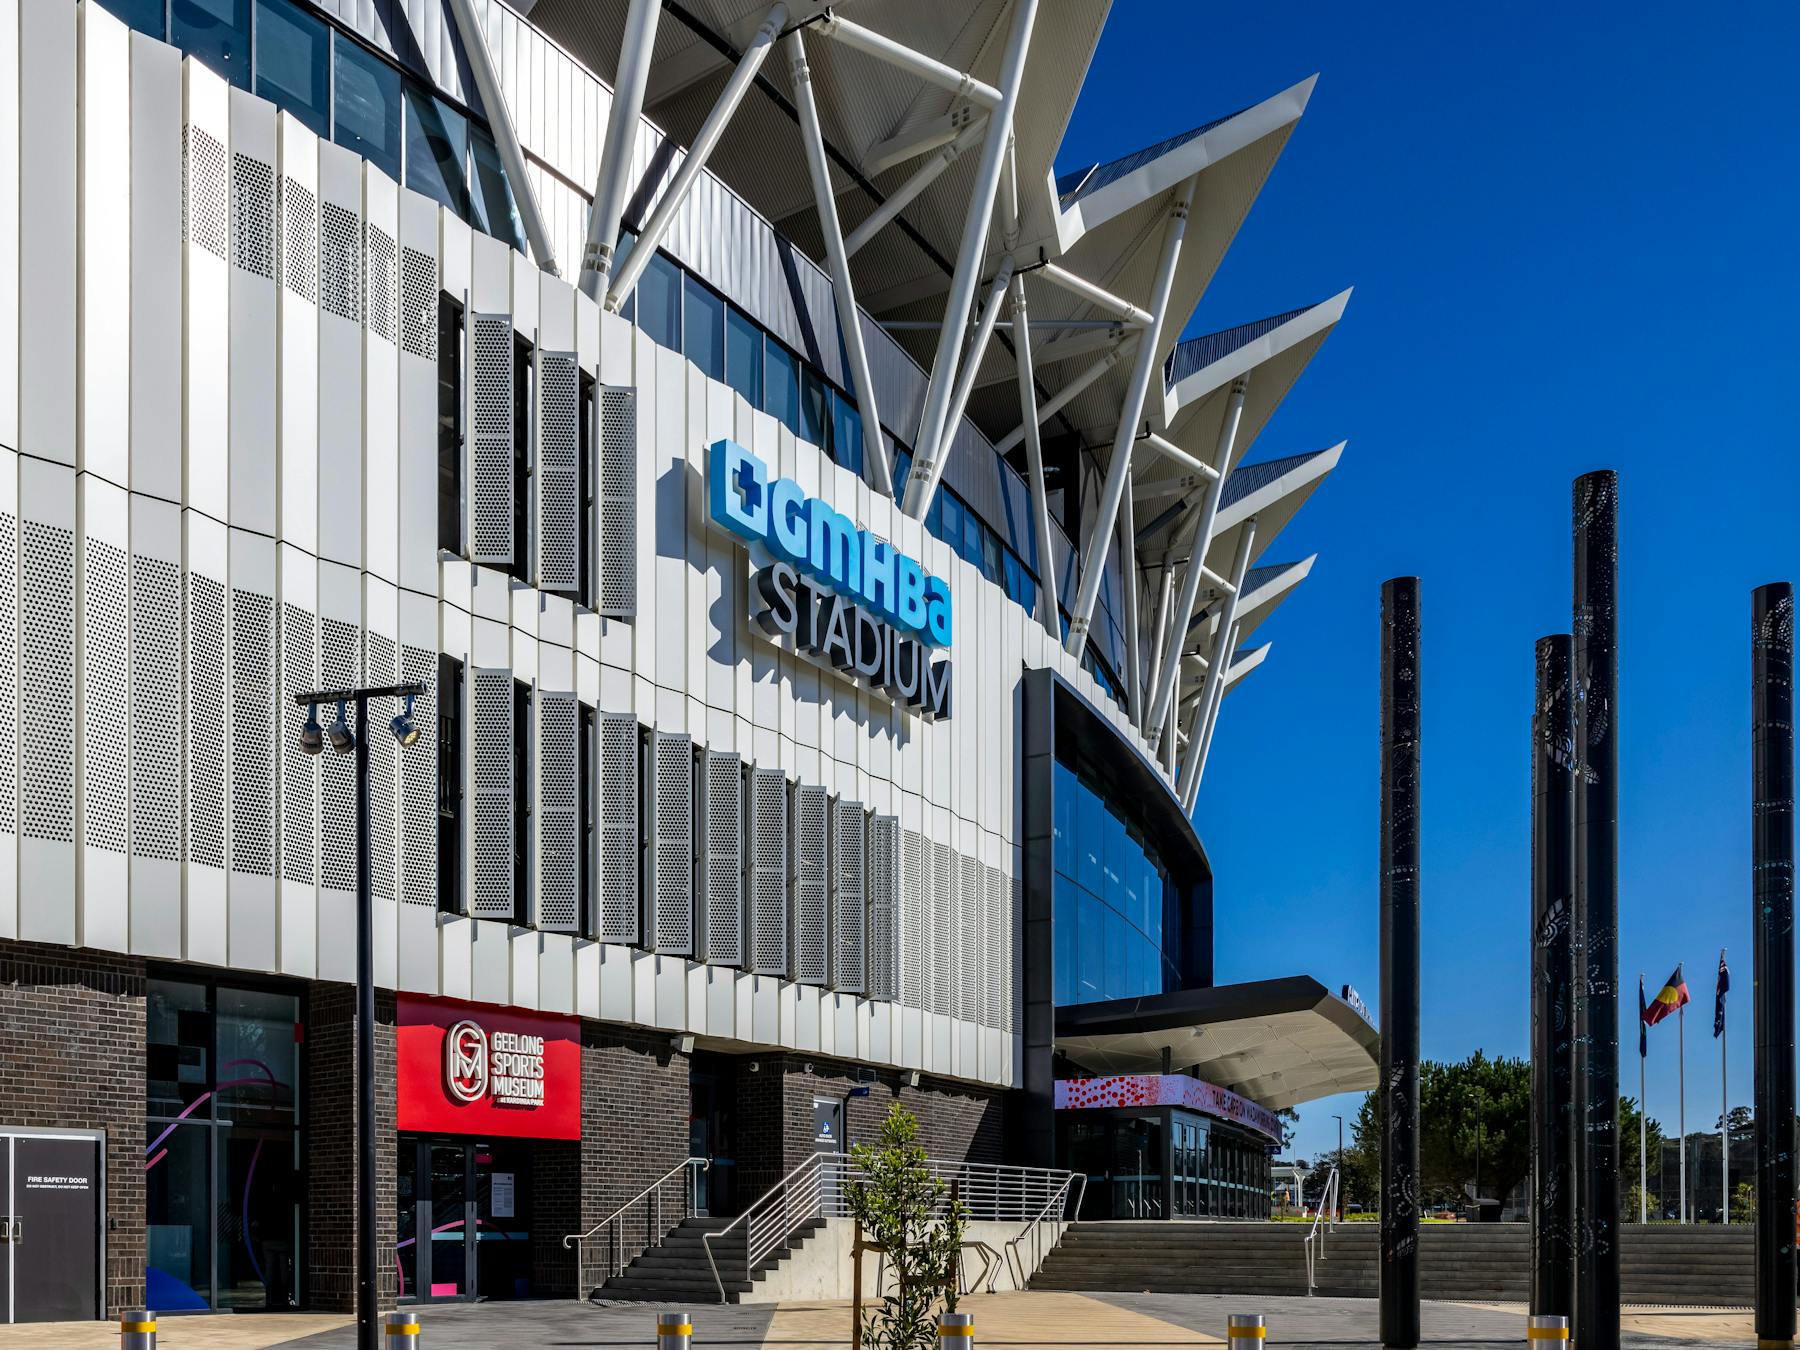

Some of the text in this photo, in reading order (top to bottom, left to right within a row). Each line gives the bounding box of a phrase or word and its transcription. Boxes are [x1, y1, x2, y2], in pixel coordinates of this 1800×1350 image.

[760, 562, 952, 720] STADIUM
[493, 1032, 544, 1055] GEELONG
[493, 1052, 544, 1078] SPORTS
[493, 1076, 544, 1098] MUSEUM
